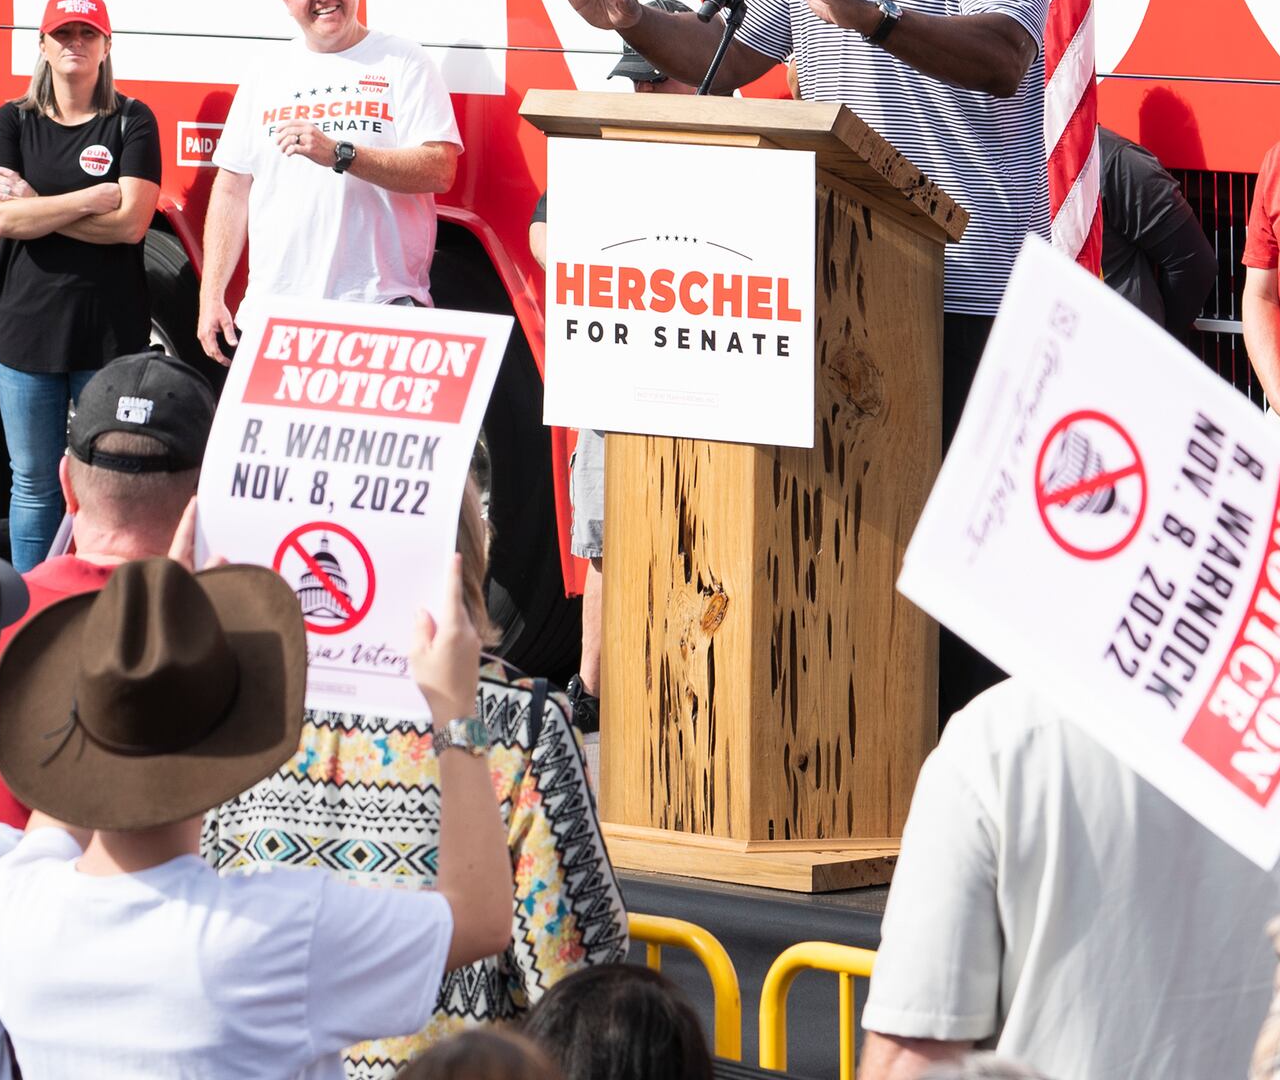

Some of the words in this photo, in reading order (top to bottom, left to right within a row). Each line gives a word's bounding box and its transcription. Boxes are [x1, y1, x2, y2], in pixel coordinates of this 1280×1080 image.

[263, 101, 393, 125] HERSCHEL
[314, 119, 382, 134] ENATE
[86, 148, 109, 158] RUN
[185, 136, 214, 153] PAID
[84, 162, 105, 172] RUN
[556, 262, 802, 322] HERSCHEL
[263, 324, 477, 378] EVICTION
[566, 319, 629, 345] FOR
[654, 326, 790, 357] SENATE
[274, 366, 440, 414] NOTICE
[239, 418, 267, 455] R.
[285, 423, 441, 471] WARNOCK
[1173, 411, 1225, 499] NOV.
[1228, 442, 1265, 482] R.
[231, 463, 293, 503] NOV.
[310, 471, 335, 514] 8,
[350, 475, 431, 516] 2022
[1151, 513, 1197, 549] 8,
[1104, 565, 1176, 678] 2022
[1145, 501, 1254, 710] WARNOCK
